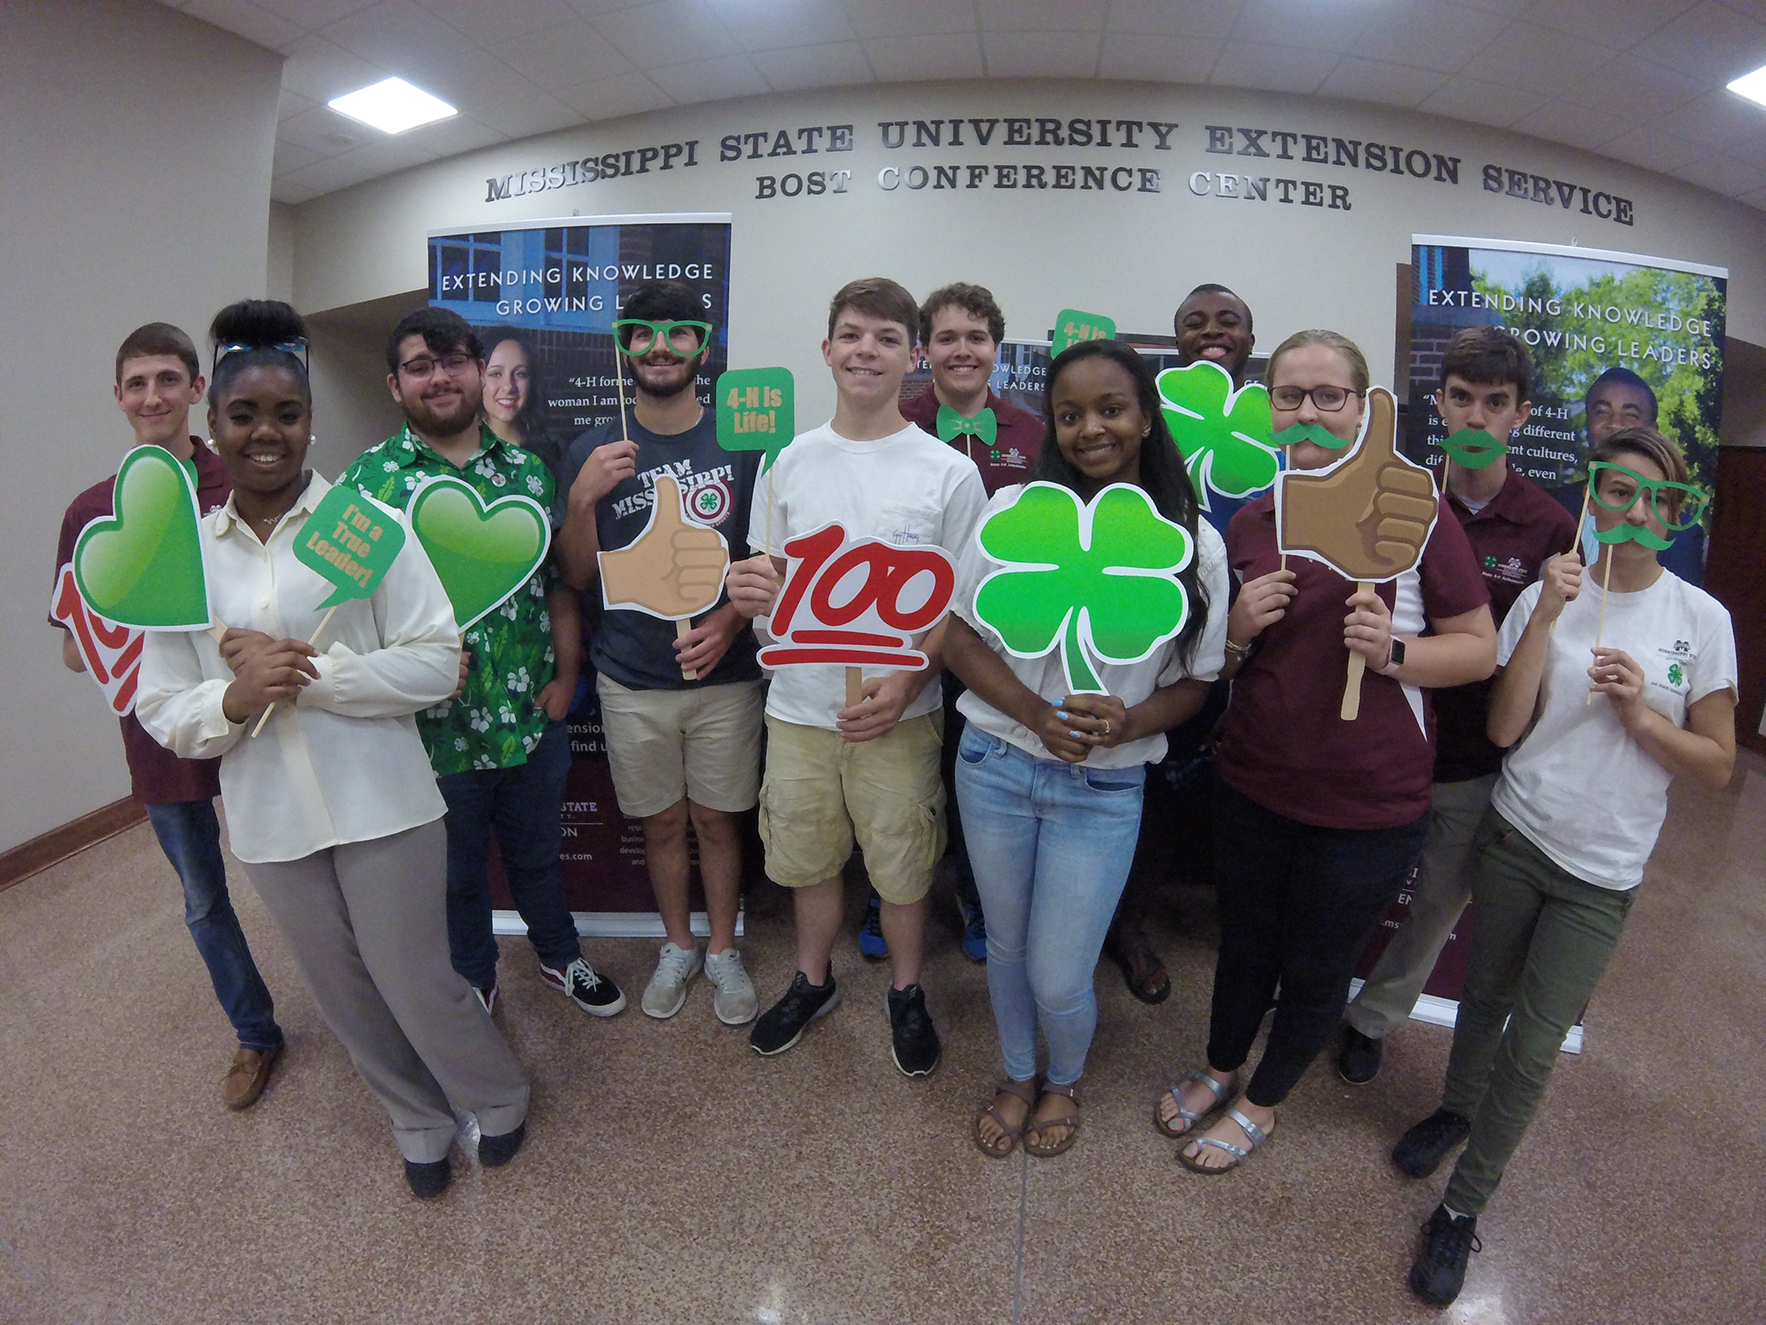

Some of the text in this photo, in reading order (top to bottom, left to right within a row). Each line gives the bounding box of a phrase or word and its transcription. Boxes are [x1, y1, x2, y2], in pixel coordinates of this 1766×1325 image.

[485, 118, 1634, 226] MISSISSIPPI STATE UNIVERSITY EXTENSION SERVICE
[755, 164, 1351, 211] BOST CONFERENCE CENTER
[442, 264, 713, 291] EXTENDING KNOWLEDGE
[496, 295, 603, 316] GROWING
[1428, 289, 1712, 338] EXTENDING KNOWLEDGE
[1494, 325, 1712, 370] ROWING LEADERS
[992, 364, 1047, 376] OWLEDGE
[600, 376, 634, 387] forme
[696, 375, 711, 385] he
[548, 398, 590, 407] woman
[592, 395, 598, 406] I
[600, 397, 618, 406] am
[726, 386, 760, 409] 4-H
[574, 416, 616, 428] me gro
[734, 410, 776, 434] Life!
[1428, 415, 1439, 426] is
[1530, 406, 1569, 420] of 4-H
[1523, 424, 1576, 441] different
[1526, 444, 1579, 464] cultures,
[1528, 468, 1557, 480] even
[612, 465, 735, 520] MISSSIPPI
[332, 520, 371, 558] True
[369, 525, 383, 542] a
[306, 531, 374, 588] Leader!
[771, 524, 955, 637] 100
[570, 740, 597, 752] find
[560, 802, 598, 812] STATE
